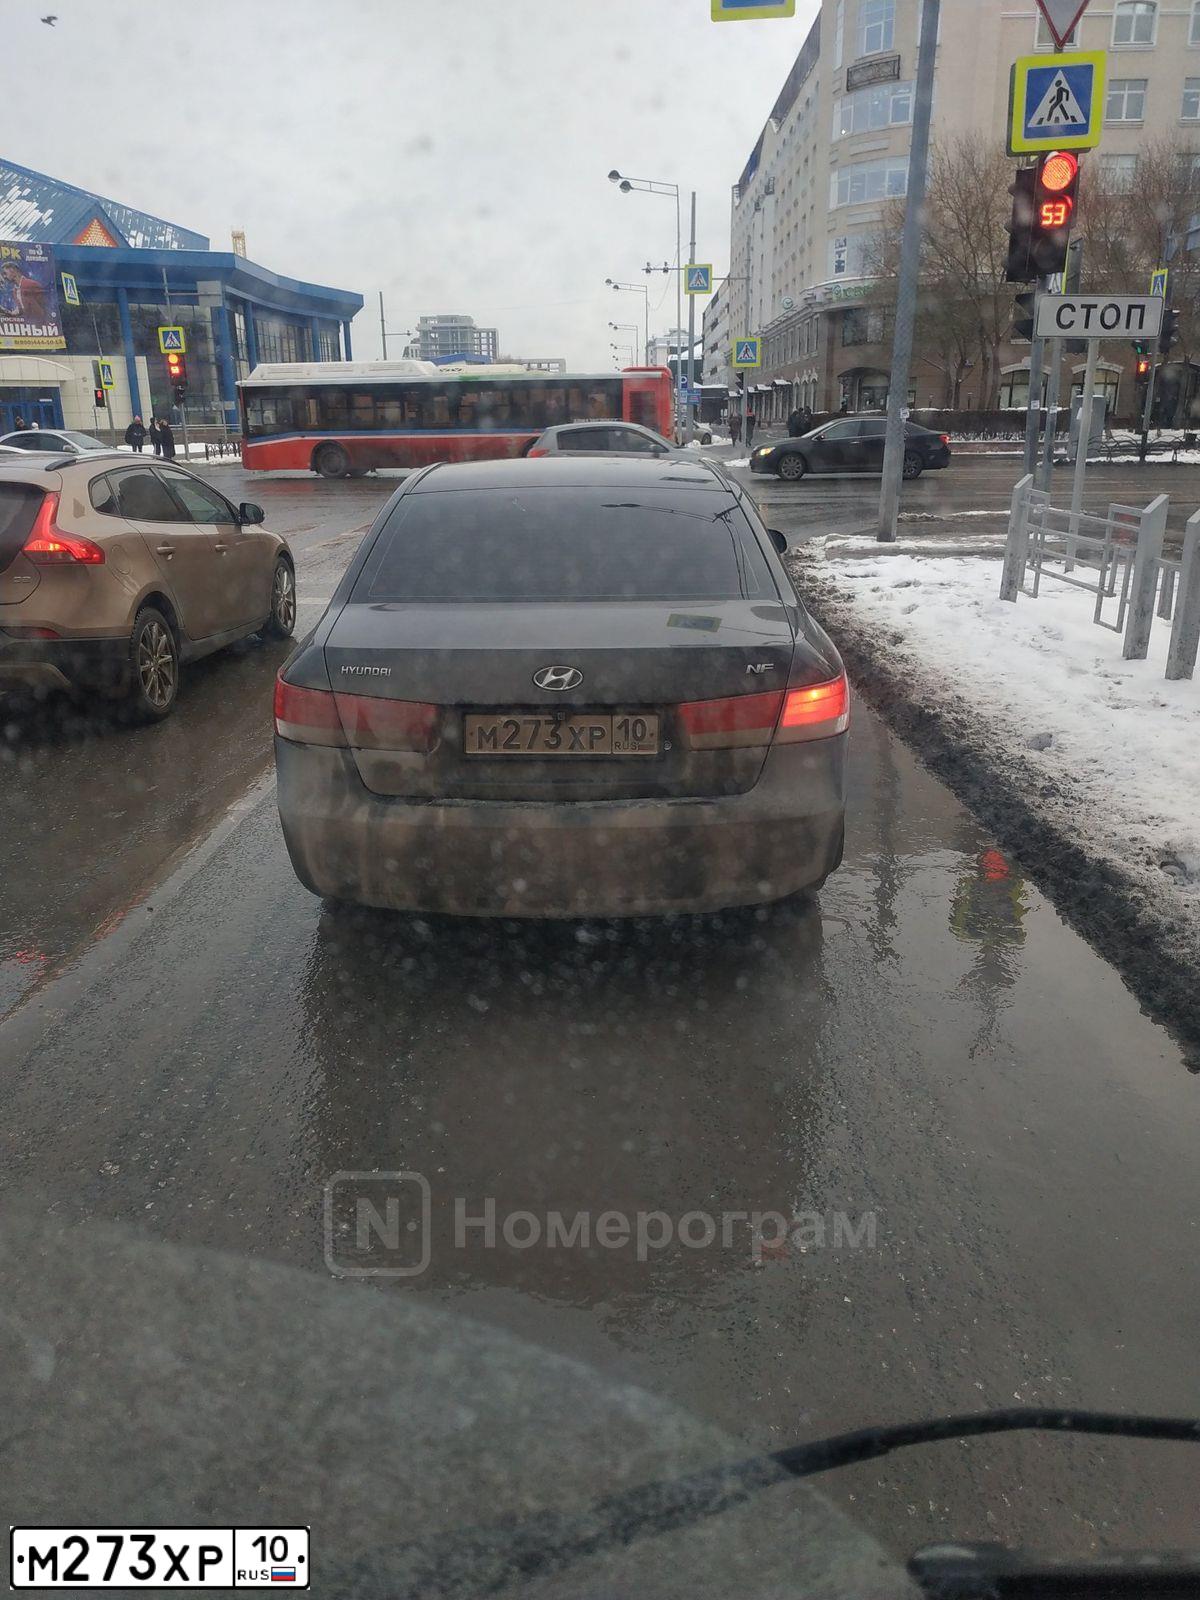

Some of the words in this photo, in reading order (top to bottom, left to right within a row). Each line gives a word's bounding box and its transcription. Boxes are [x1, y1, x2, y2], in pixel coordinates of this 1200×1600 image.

[1041, 204, 1065, 225] 53
[0, 246, 21, 260] РК
[36, 245, 43, 255] 3
[1056, 303, 1146, 330] СТОП
[341, 665, 391, 676] HYUNDAI
[745, 663, 774, 674] NF
[477, 719, 606, 750] М273ХР
[617, 718, 647, 742] 10
[615, 742, 638, 750] RUS
